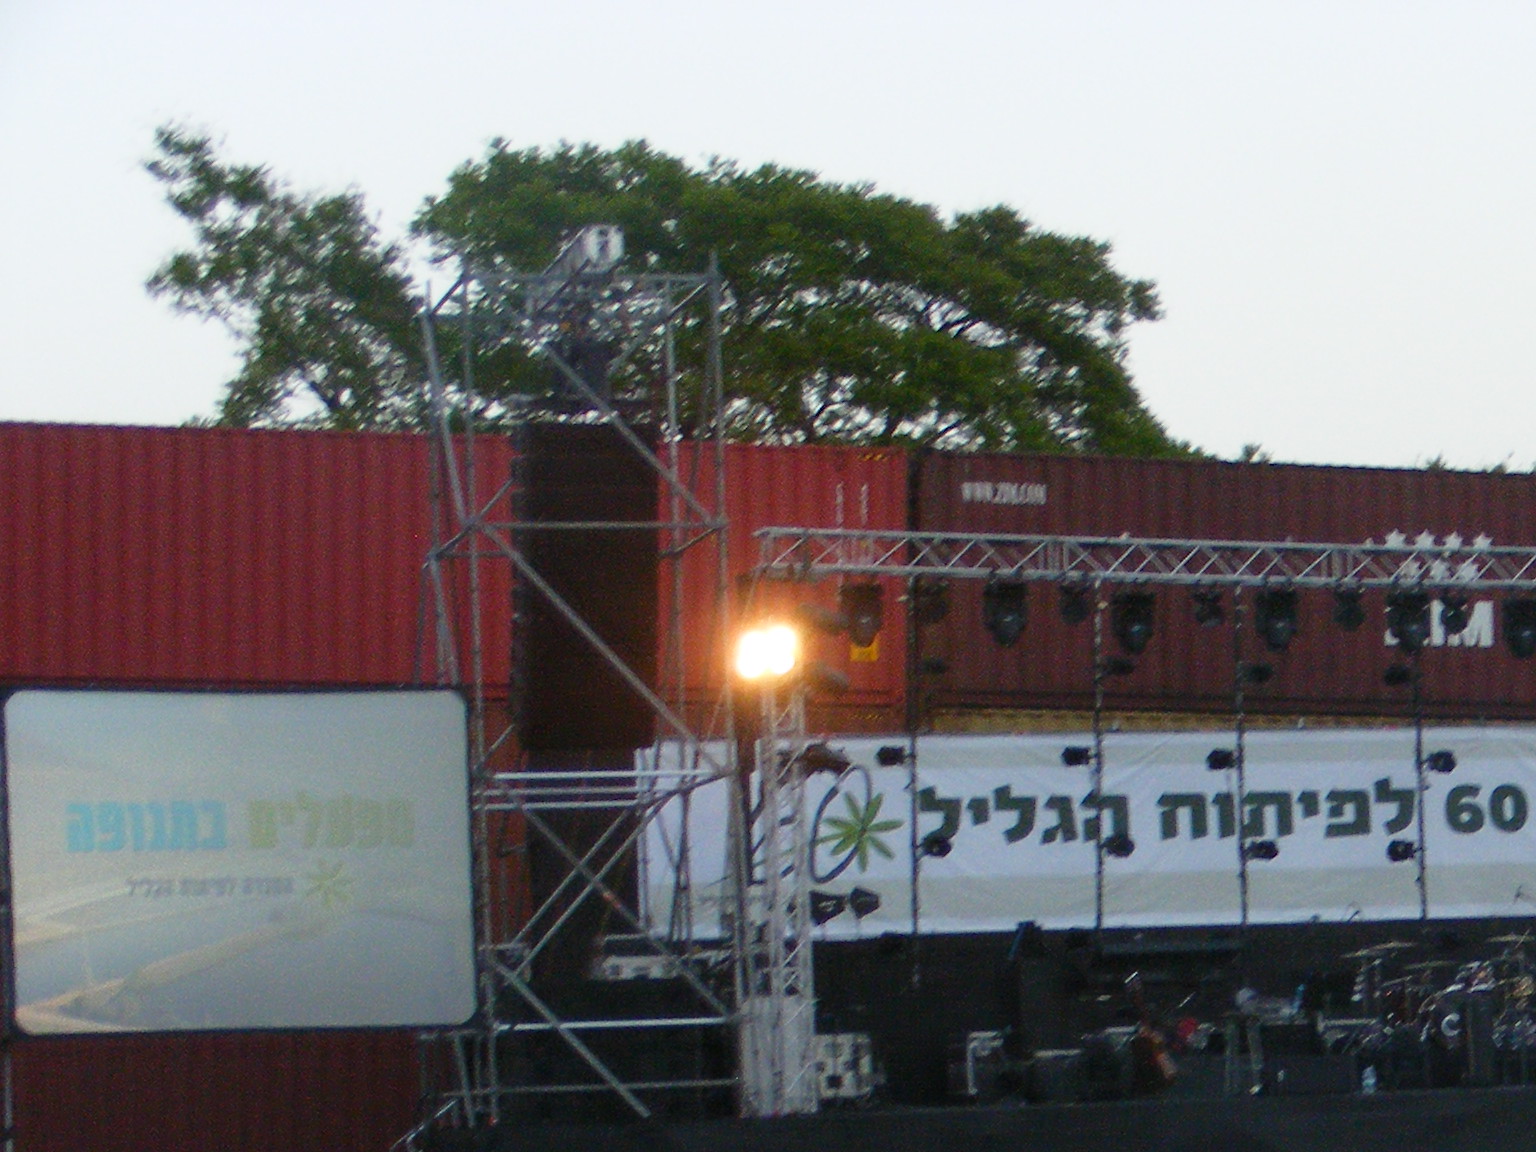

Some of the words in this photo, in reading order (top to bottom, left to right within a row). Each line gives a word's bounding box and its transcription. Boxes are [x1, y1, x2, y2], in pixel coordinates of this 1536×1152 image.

[1383, 599, 1495, 647] IM
[918, 784, 1130, 844] הגליל
[1156, 777, 1417, 841] לפיתוח
